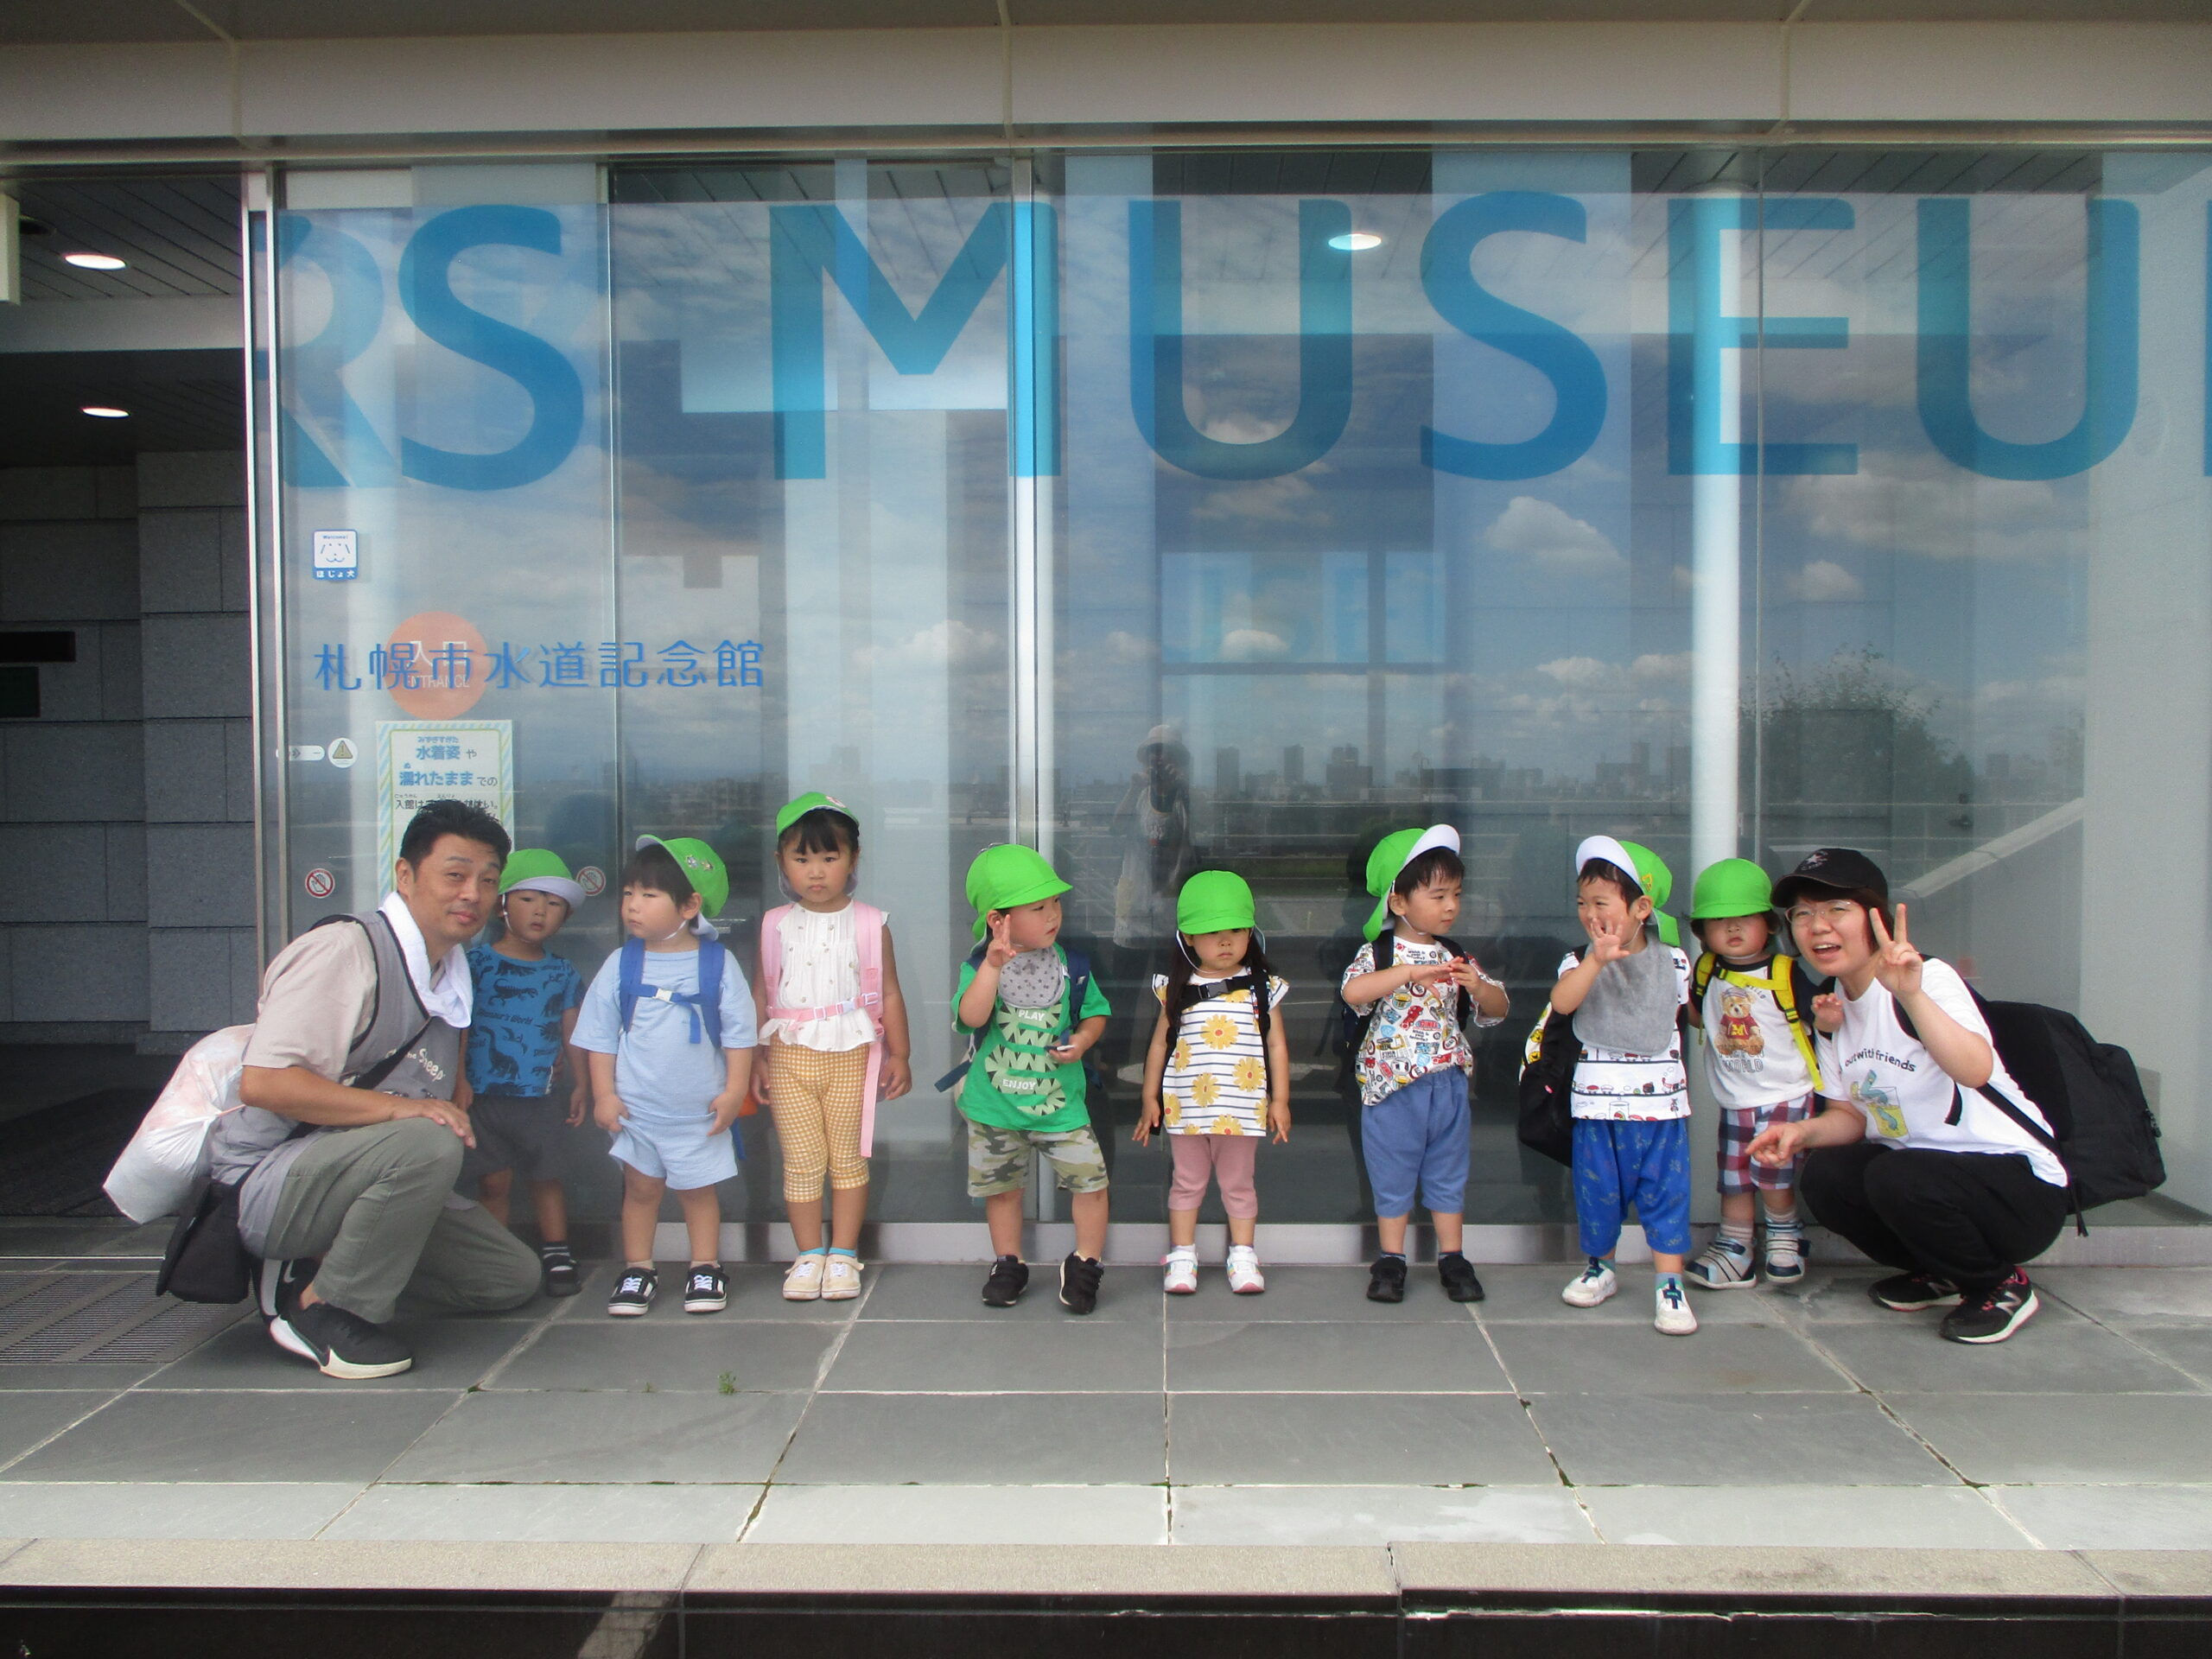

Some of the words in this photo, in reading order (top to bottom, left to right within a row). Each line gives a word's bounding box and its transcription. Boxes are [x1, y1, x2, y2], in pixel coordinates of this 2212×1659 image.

[768, 190, 2212, 482] MUSEU
[313, 639, 765, 691] 札幌市水道記念館
[1019, 1009, 1045, 1021] PLAY
[1002, 1079, 1036, 1090] ENJOY
